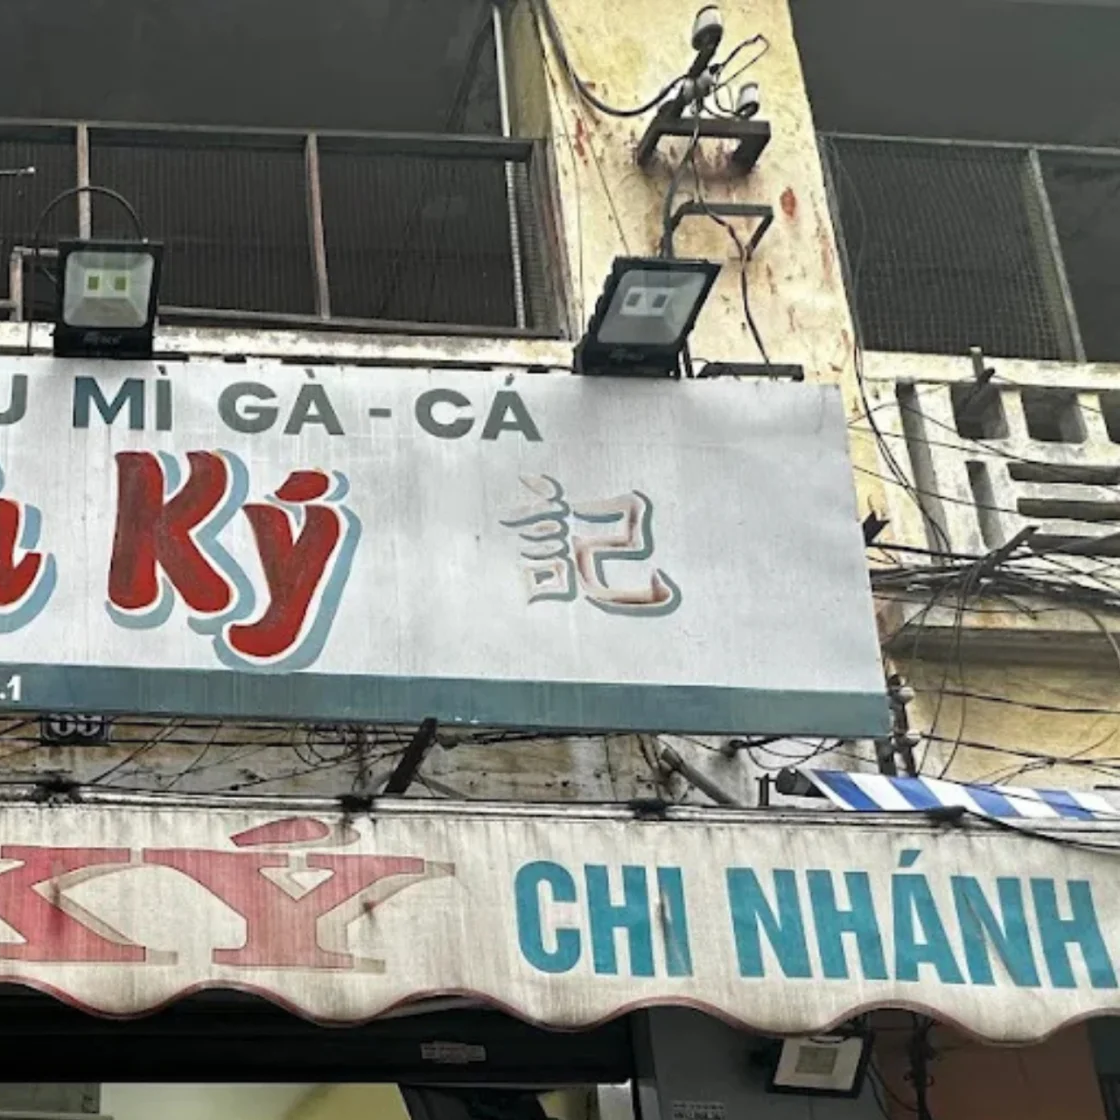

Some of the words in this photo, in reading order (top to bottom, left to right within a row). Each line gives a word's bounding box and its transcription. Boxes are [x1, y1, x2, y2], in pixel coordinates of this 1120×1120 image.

[72, 366, 173, 431] MÌ
[105, 447, 362, 673] Ký
[499, 473, 682, 617] 記
[513, 859, 694, 978] CHI
[726, 849, 1119, 989] NHÁNH
